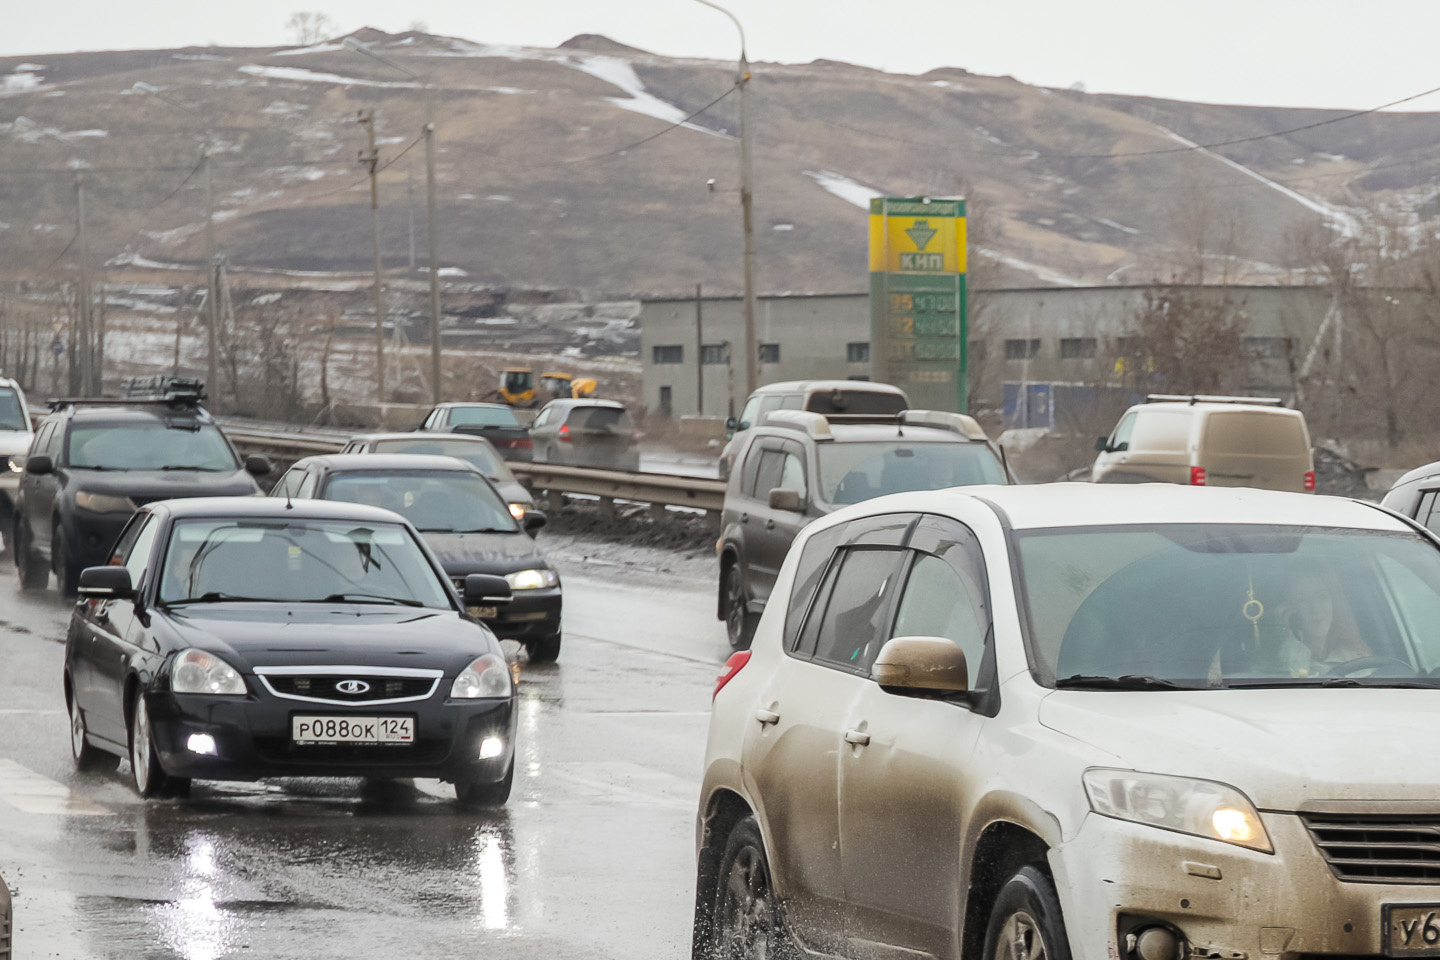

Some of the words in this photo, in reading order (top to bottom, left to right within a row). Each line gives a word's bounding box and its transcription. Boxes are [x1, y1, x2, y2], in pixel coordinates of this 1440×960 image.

[901, 253, 941, 269] КНП
[299, 719, 375, 738] Р088ОК
[380, 719, 411, 735] 124
